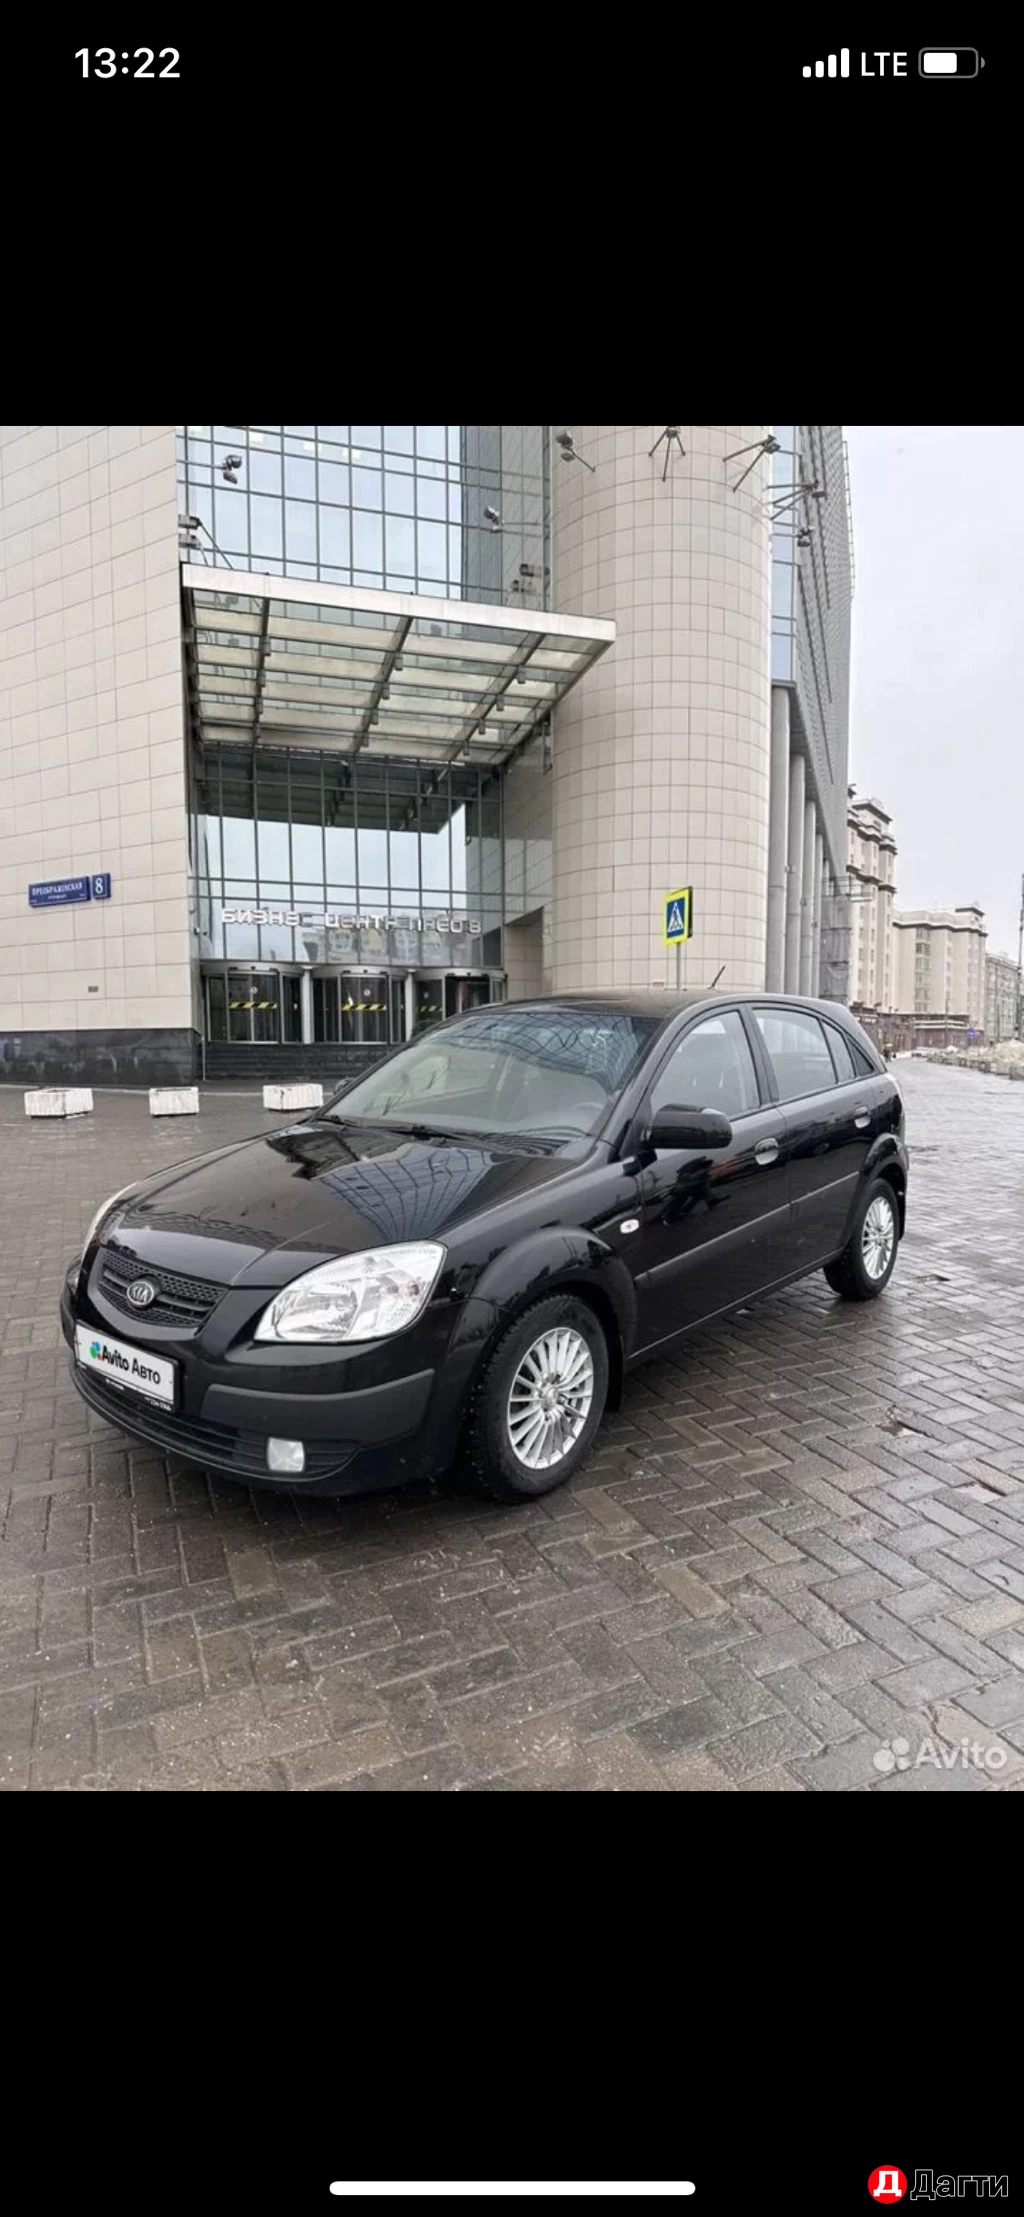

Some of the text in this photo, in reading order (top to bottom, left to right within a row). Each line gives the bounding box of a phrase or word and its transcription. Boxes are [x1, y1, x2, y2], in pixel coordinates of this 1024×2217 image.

[95, 877, 104, 895] 8
[222, 908, 313, 928] БИЗНЕС
[325, 912, 397, 931] ЦЕНТР
[102, 1345, 130, 1372] Avito
